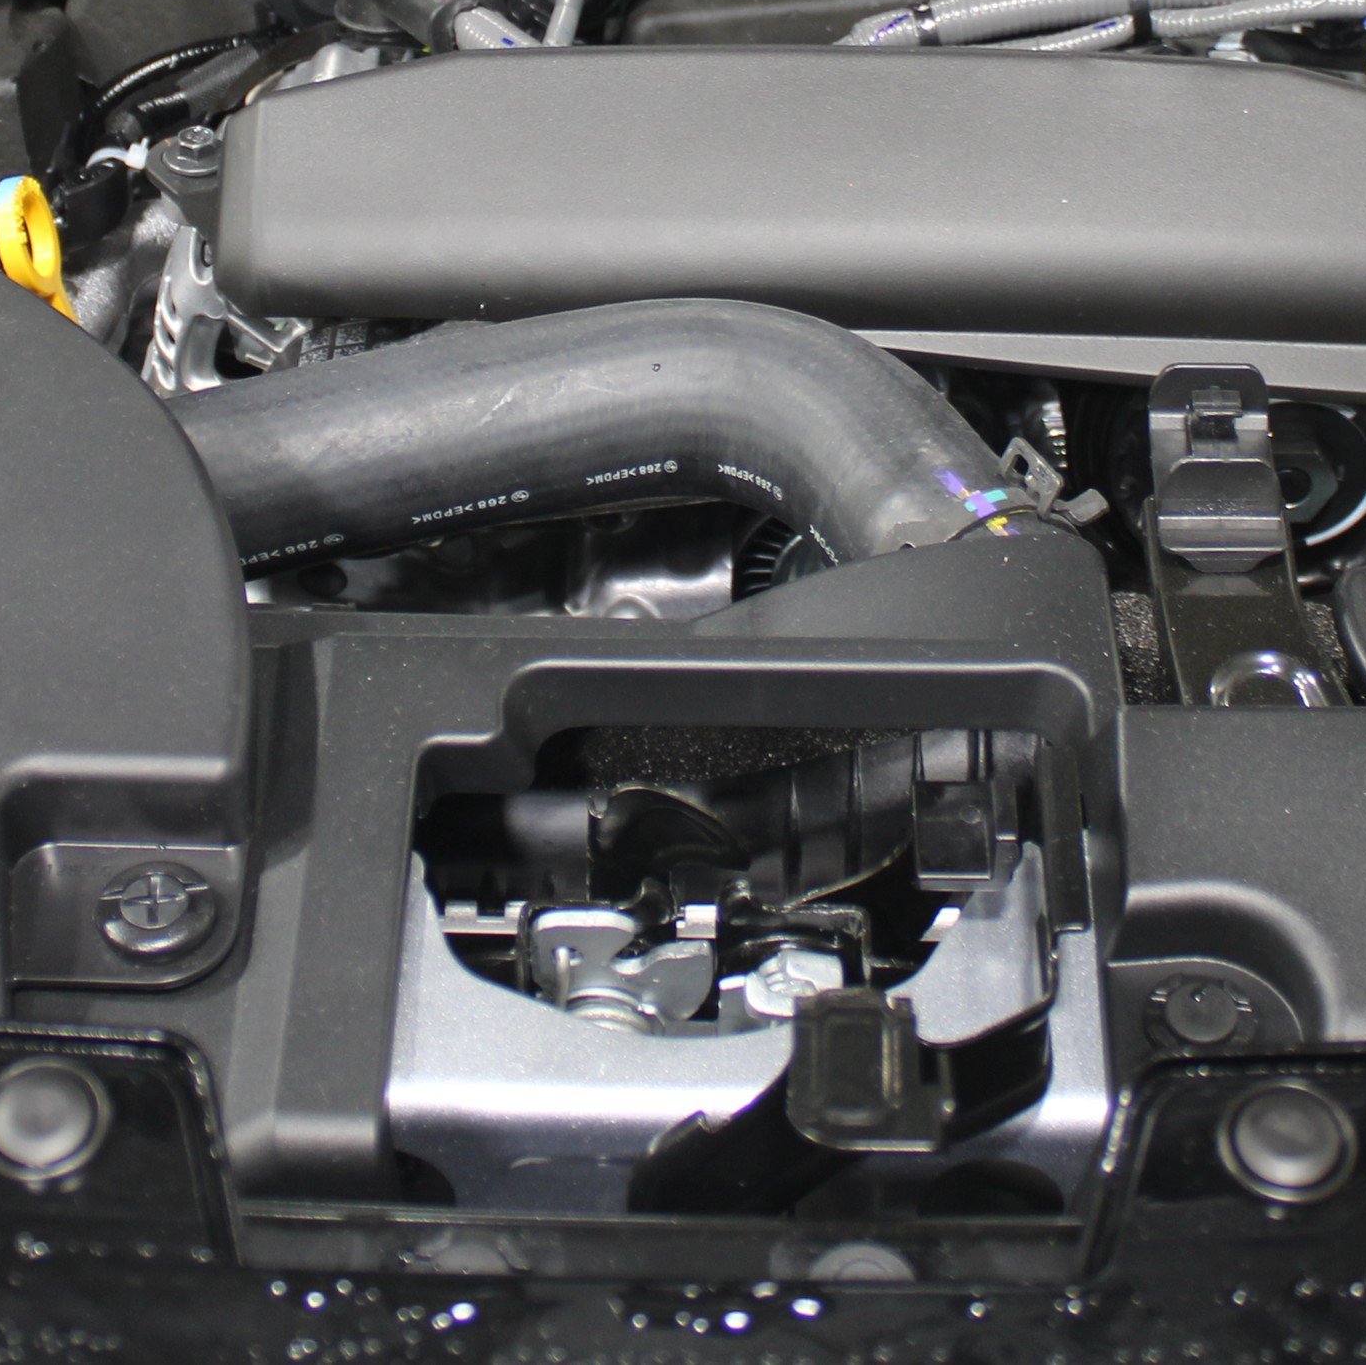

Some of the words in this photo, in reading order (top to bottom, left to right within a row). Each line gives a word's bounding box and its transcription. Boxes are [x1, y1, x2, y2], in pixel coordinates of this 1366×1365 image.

[639, 463, 662, 476] 268
[477, 495, 508, 510] 268
[284, 539, 319, 555] 268
